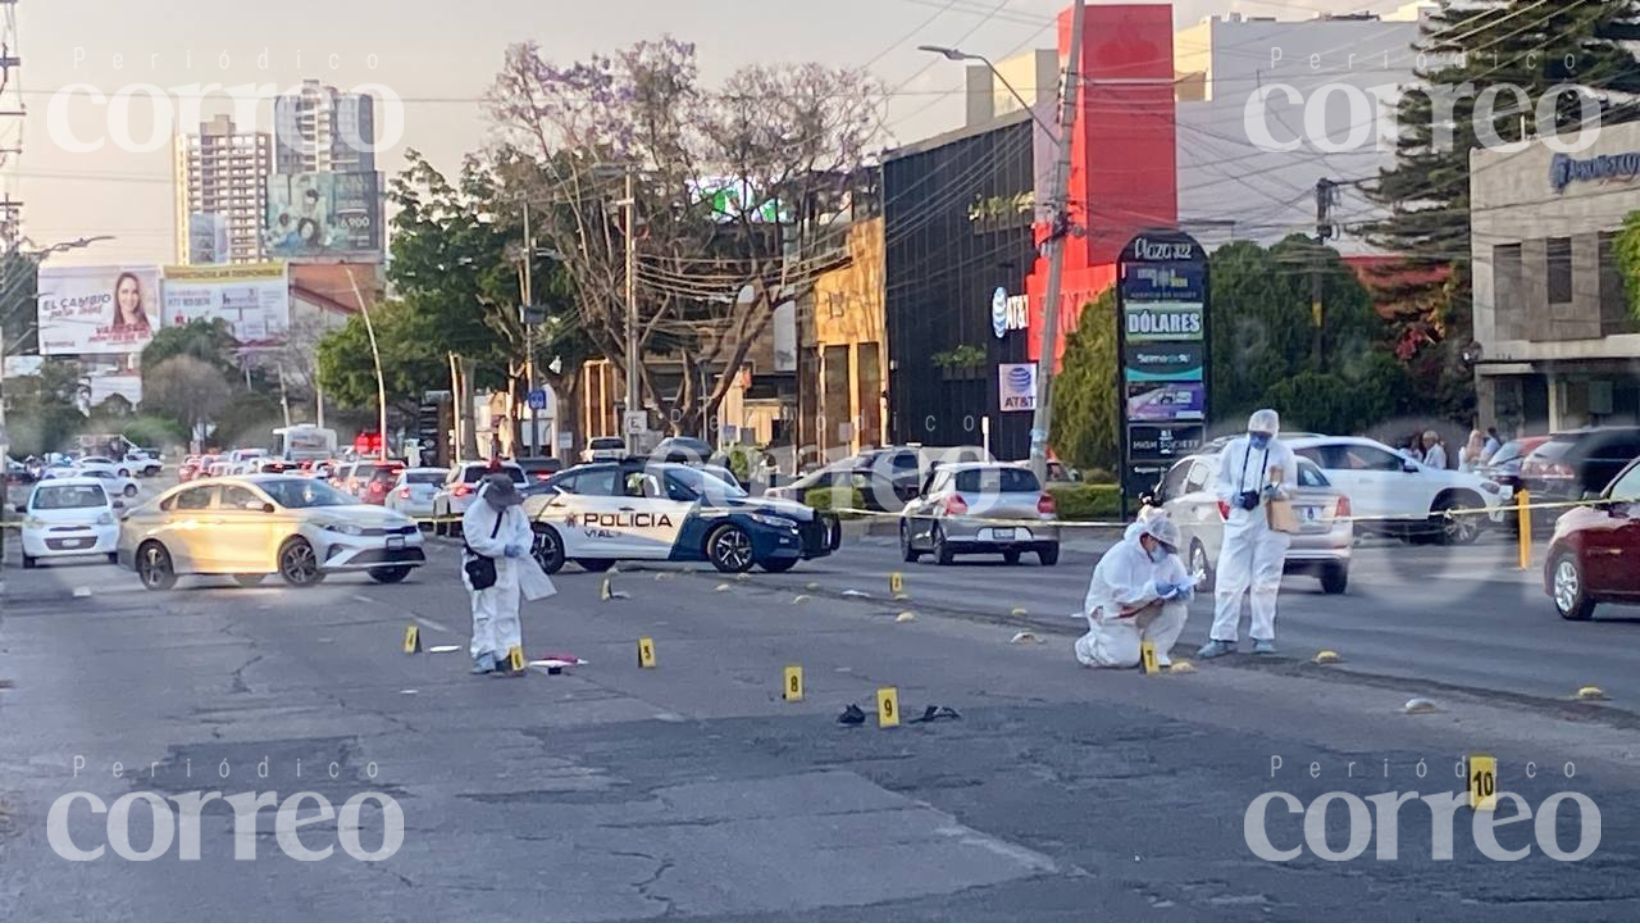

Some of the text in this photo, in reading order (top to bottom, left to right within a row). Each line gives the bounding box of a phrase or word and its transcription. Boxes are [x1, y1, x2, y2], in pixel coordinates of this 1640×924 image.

[43, 300, 57, 311] EL
[60, 294, 112, 308] CAMBIO
[1128, 309, 1200, 333] DÓLARES
[1004, 396, 1035, 408] AT&T
[584, 511, 673, 528] POLICIA
[790, 675, 799, 693] 8
[883, 698, 893, 717] 9
[1472, 770, 1494, 797] 10
